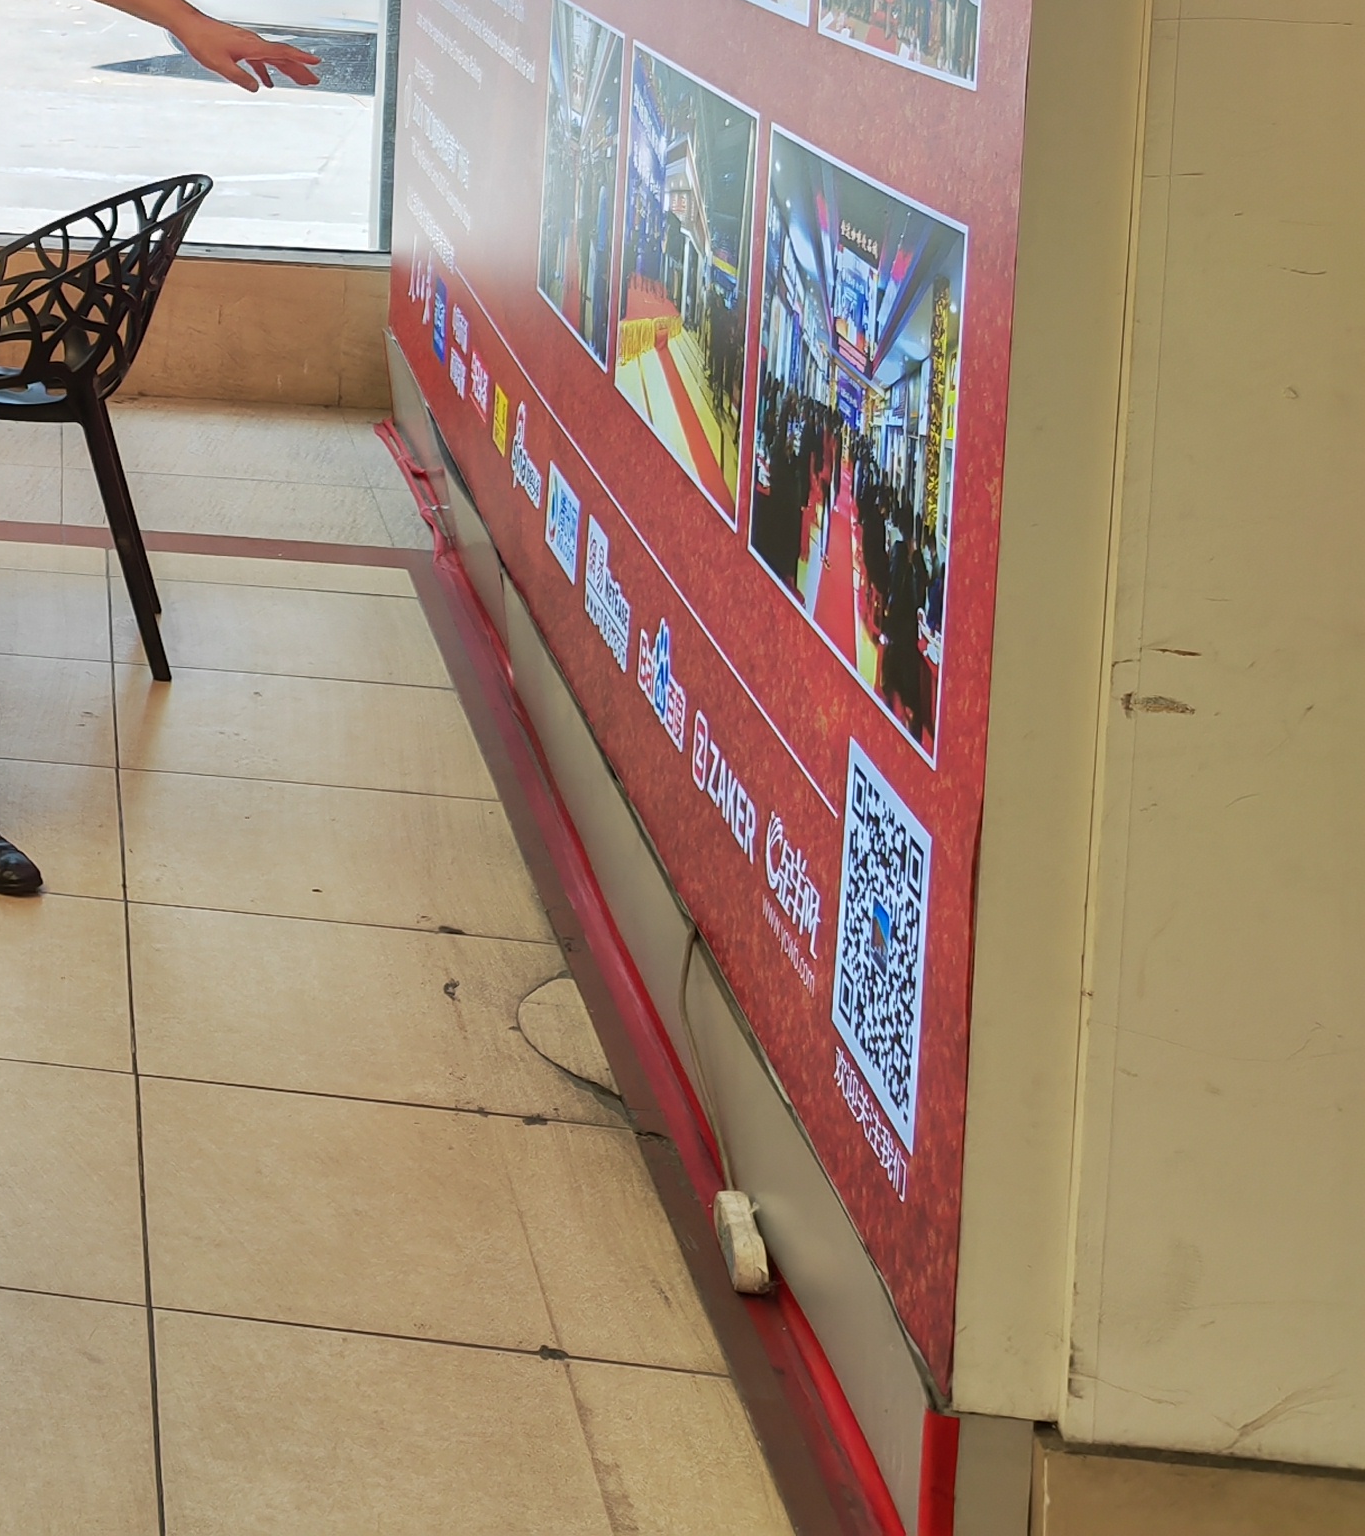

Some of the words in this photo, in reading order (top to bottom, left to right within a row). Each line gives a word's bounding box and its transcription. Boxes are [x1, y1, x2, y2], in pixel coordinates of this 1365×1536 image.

[707, 740, 756, 864] ZAKER
[762, 894, 815, 998] www.ycwb.com
[834, 1046, 907, 1203] 欢迎关注我们
